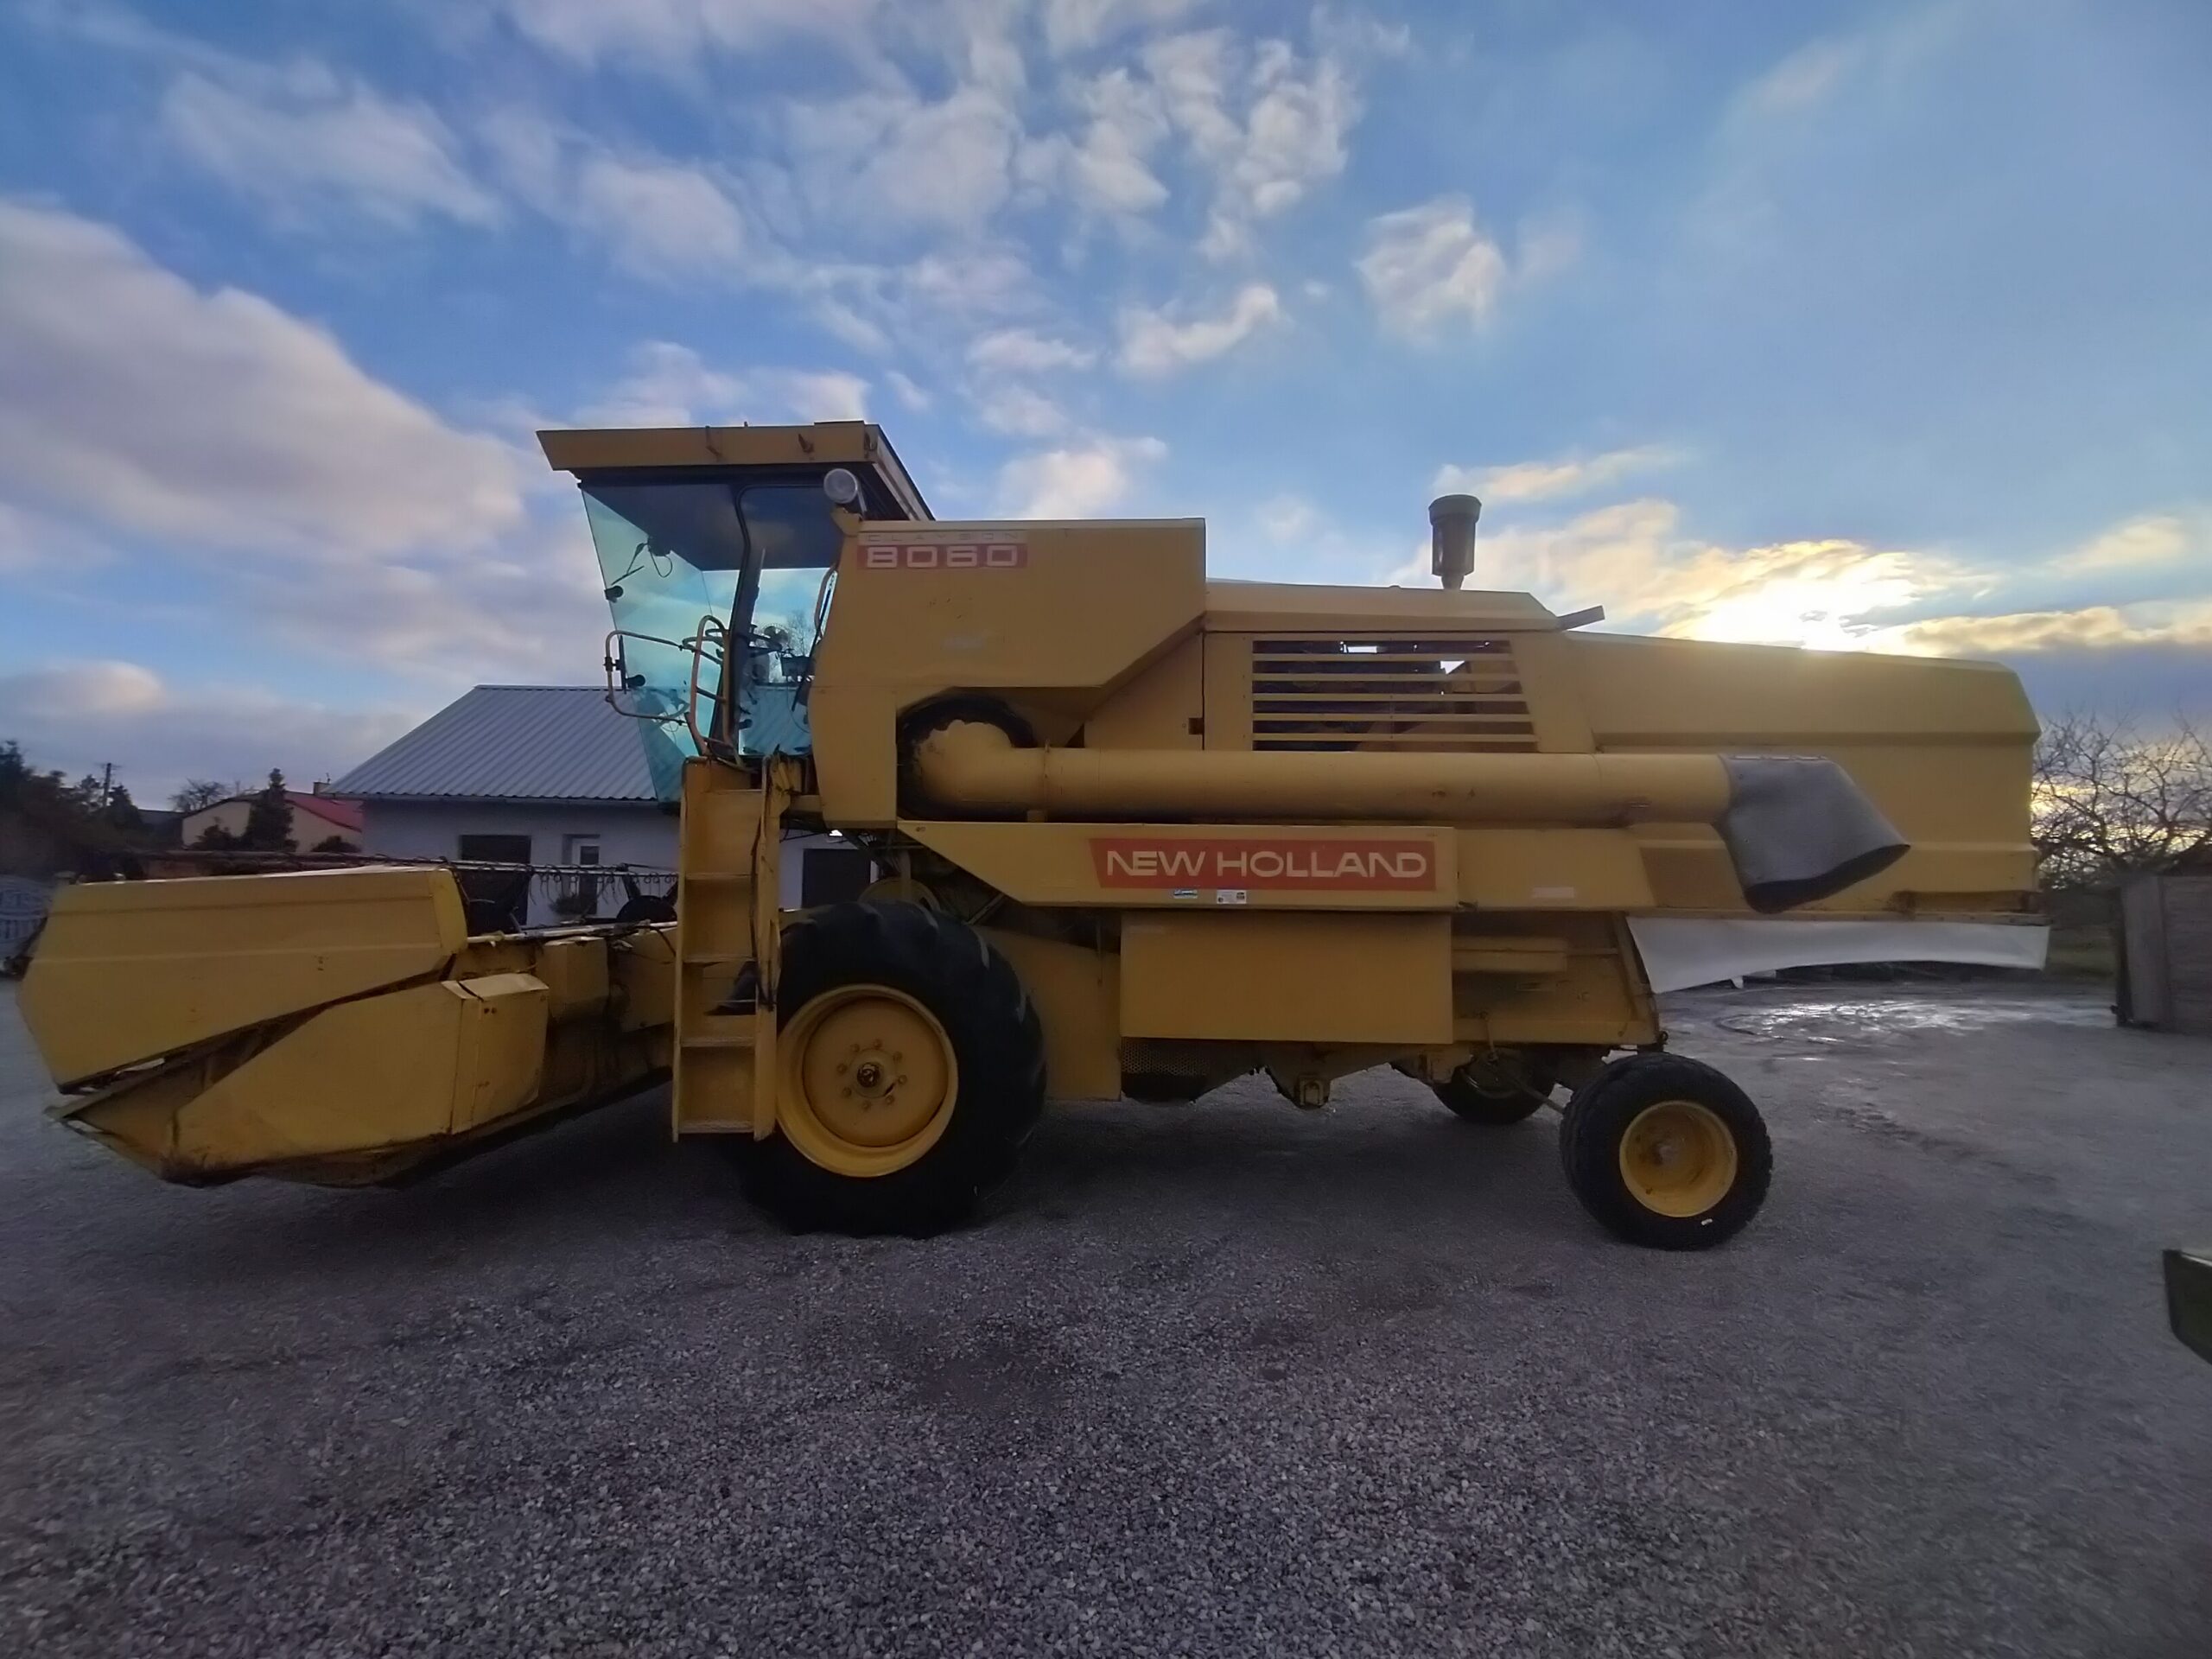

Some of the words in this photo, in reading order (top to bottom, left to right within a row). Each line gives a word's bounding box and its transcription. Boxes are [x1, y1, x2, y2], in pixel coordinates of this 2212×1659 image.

[867, 544, 1018, 569] 8060
[1107, 850, 1206, 877] NEW
[1217, 851, 1427, 879] HOLLAND
